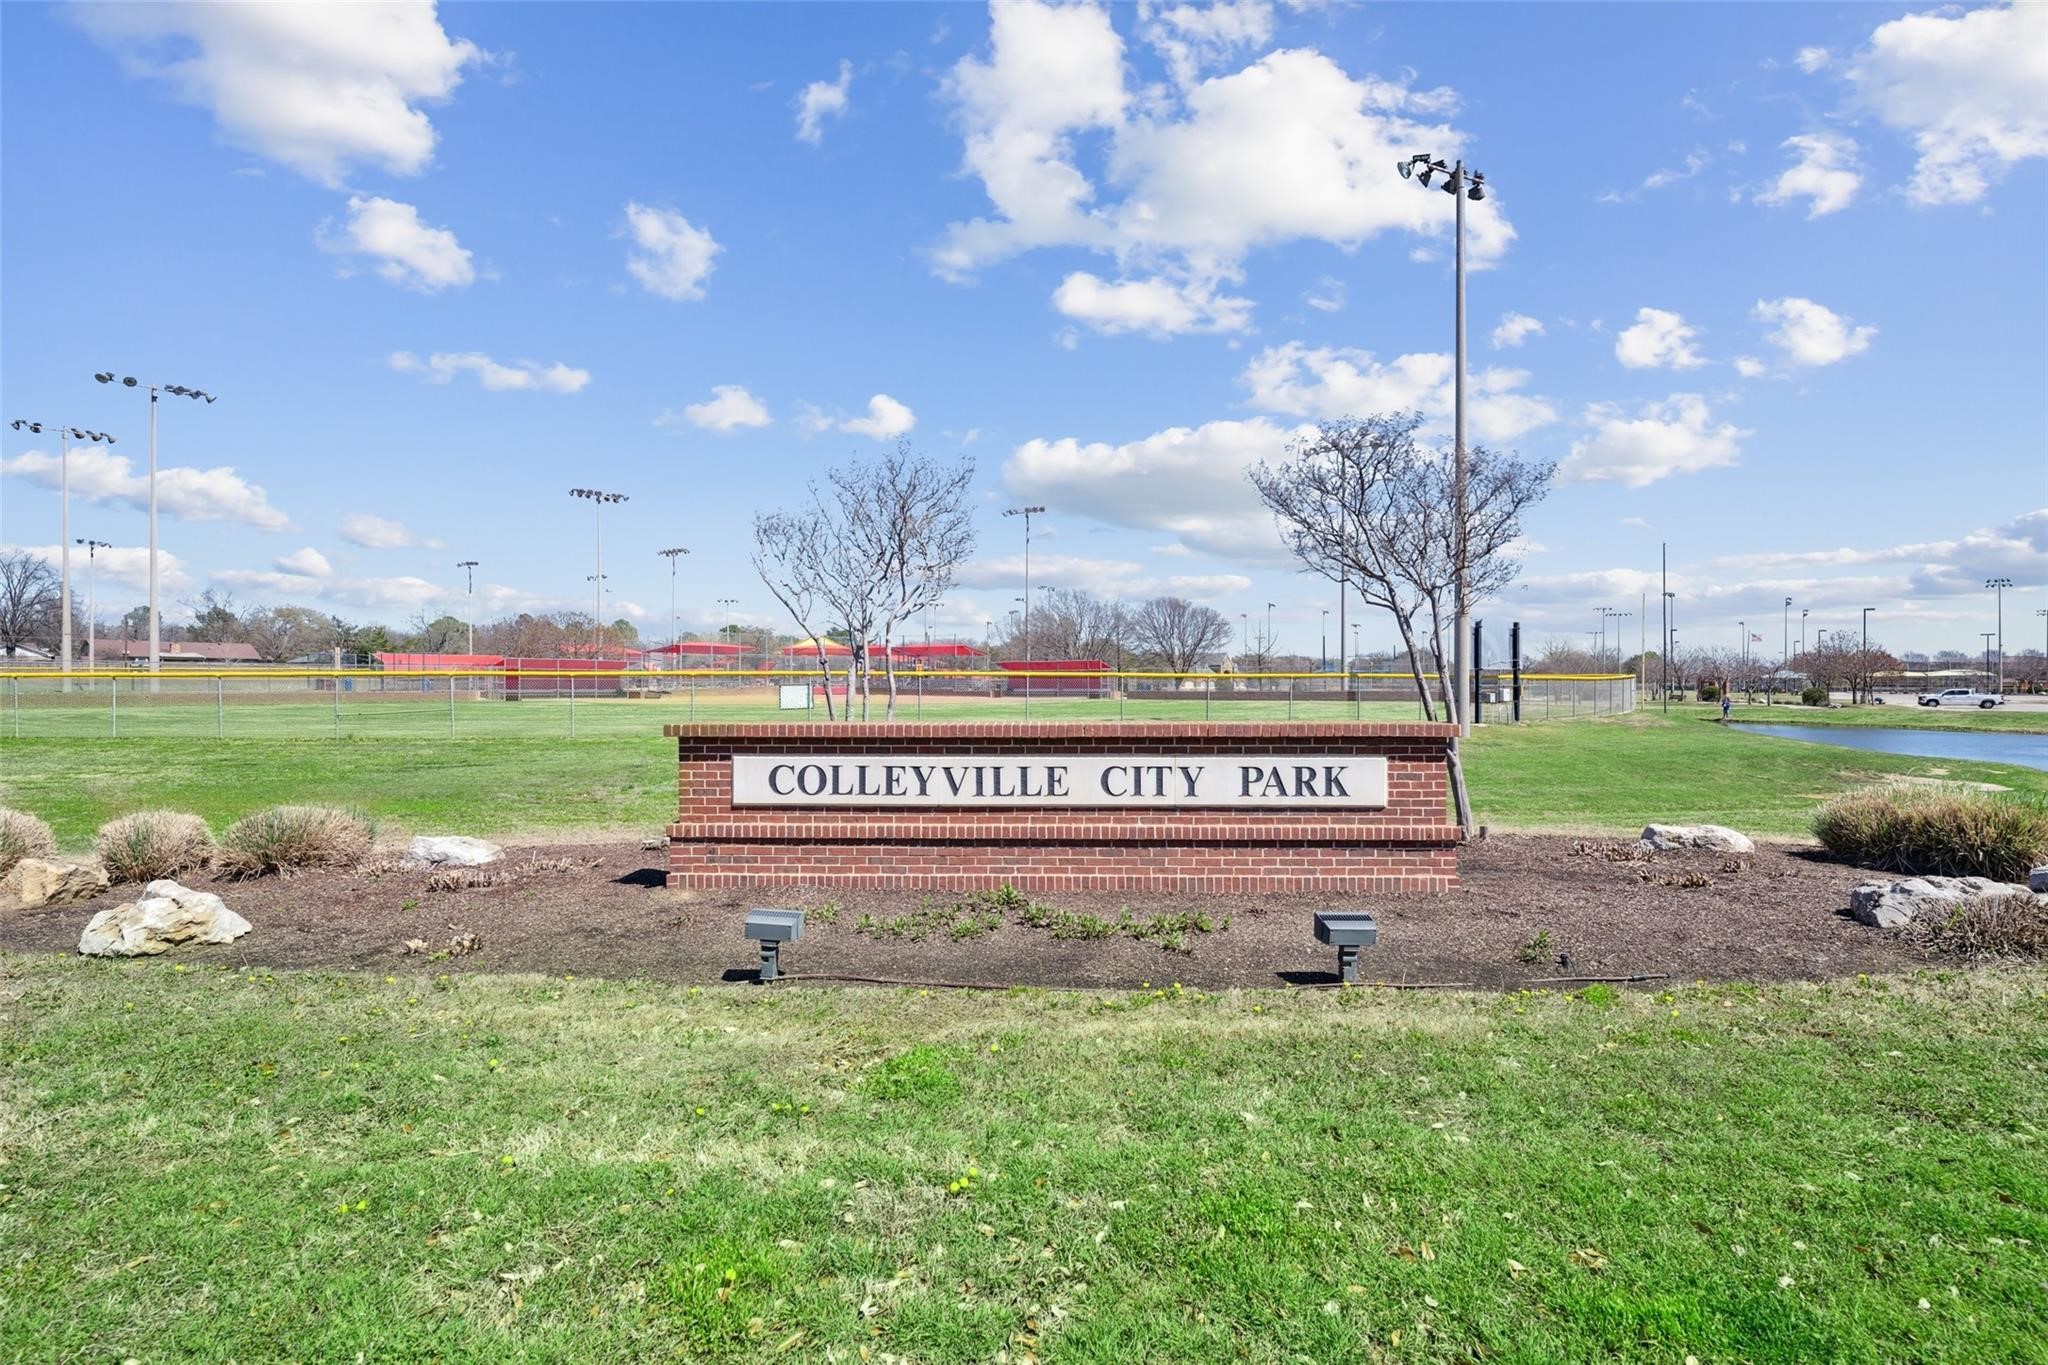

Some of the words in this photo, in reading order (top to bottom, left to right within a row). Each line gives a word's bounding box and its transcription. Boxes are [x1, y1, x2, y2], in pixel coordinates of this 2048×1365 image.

[768, 763, 1070, 797] COLLEYVILLE
[1100, 764, 1205, 797] CITY
[1237, 765, 1350, 798] PARK
